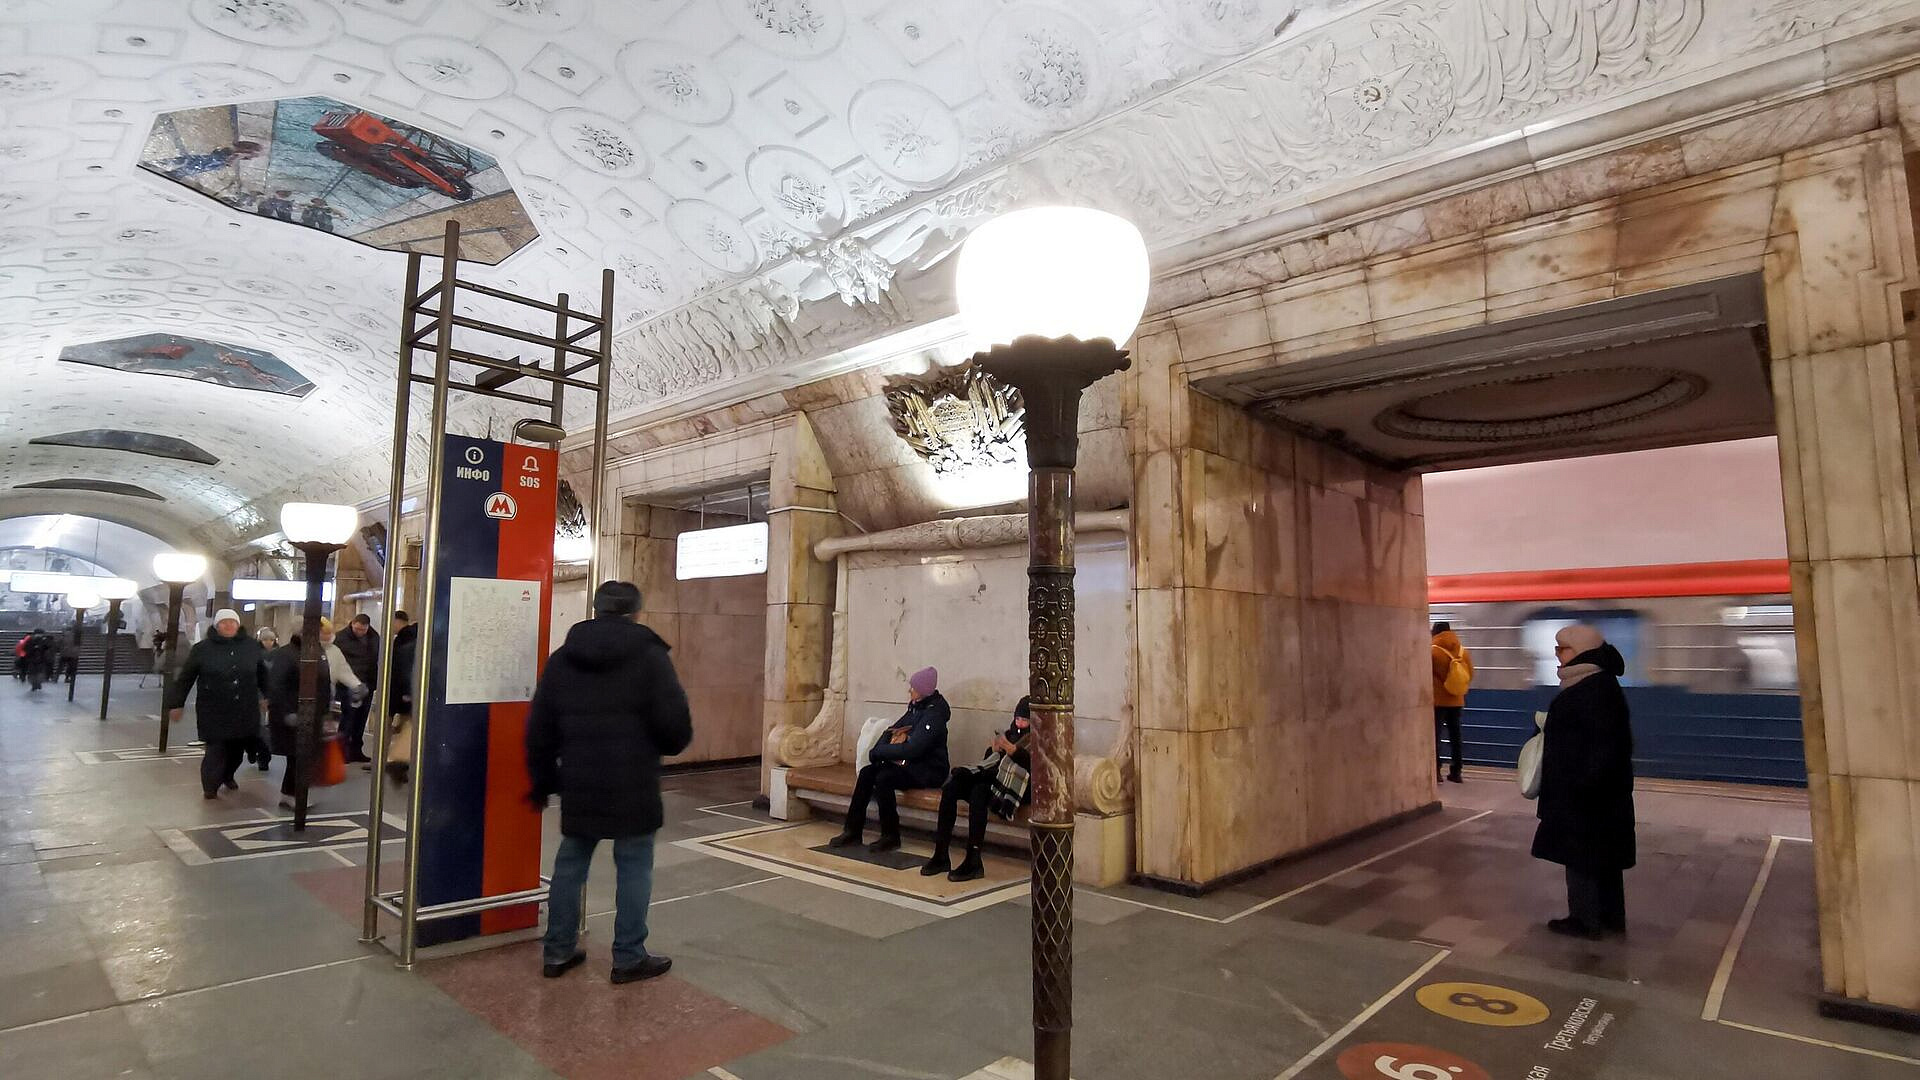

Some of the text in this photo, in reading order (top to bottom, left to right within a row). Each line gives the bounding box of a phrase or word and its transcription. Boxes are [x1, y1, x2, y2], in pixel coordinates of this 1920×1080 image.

[456, 466, 490, 482] ИНФО
[519, 475, 541, 489] SOS
[1448, 992, 1518, 1015] 8
[1543, 997, 1600, 1051] Третьяковская
